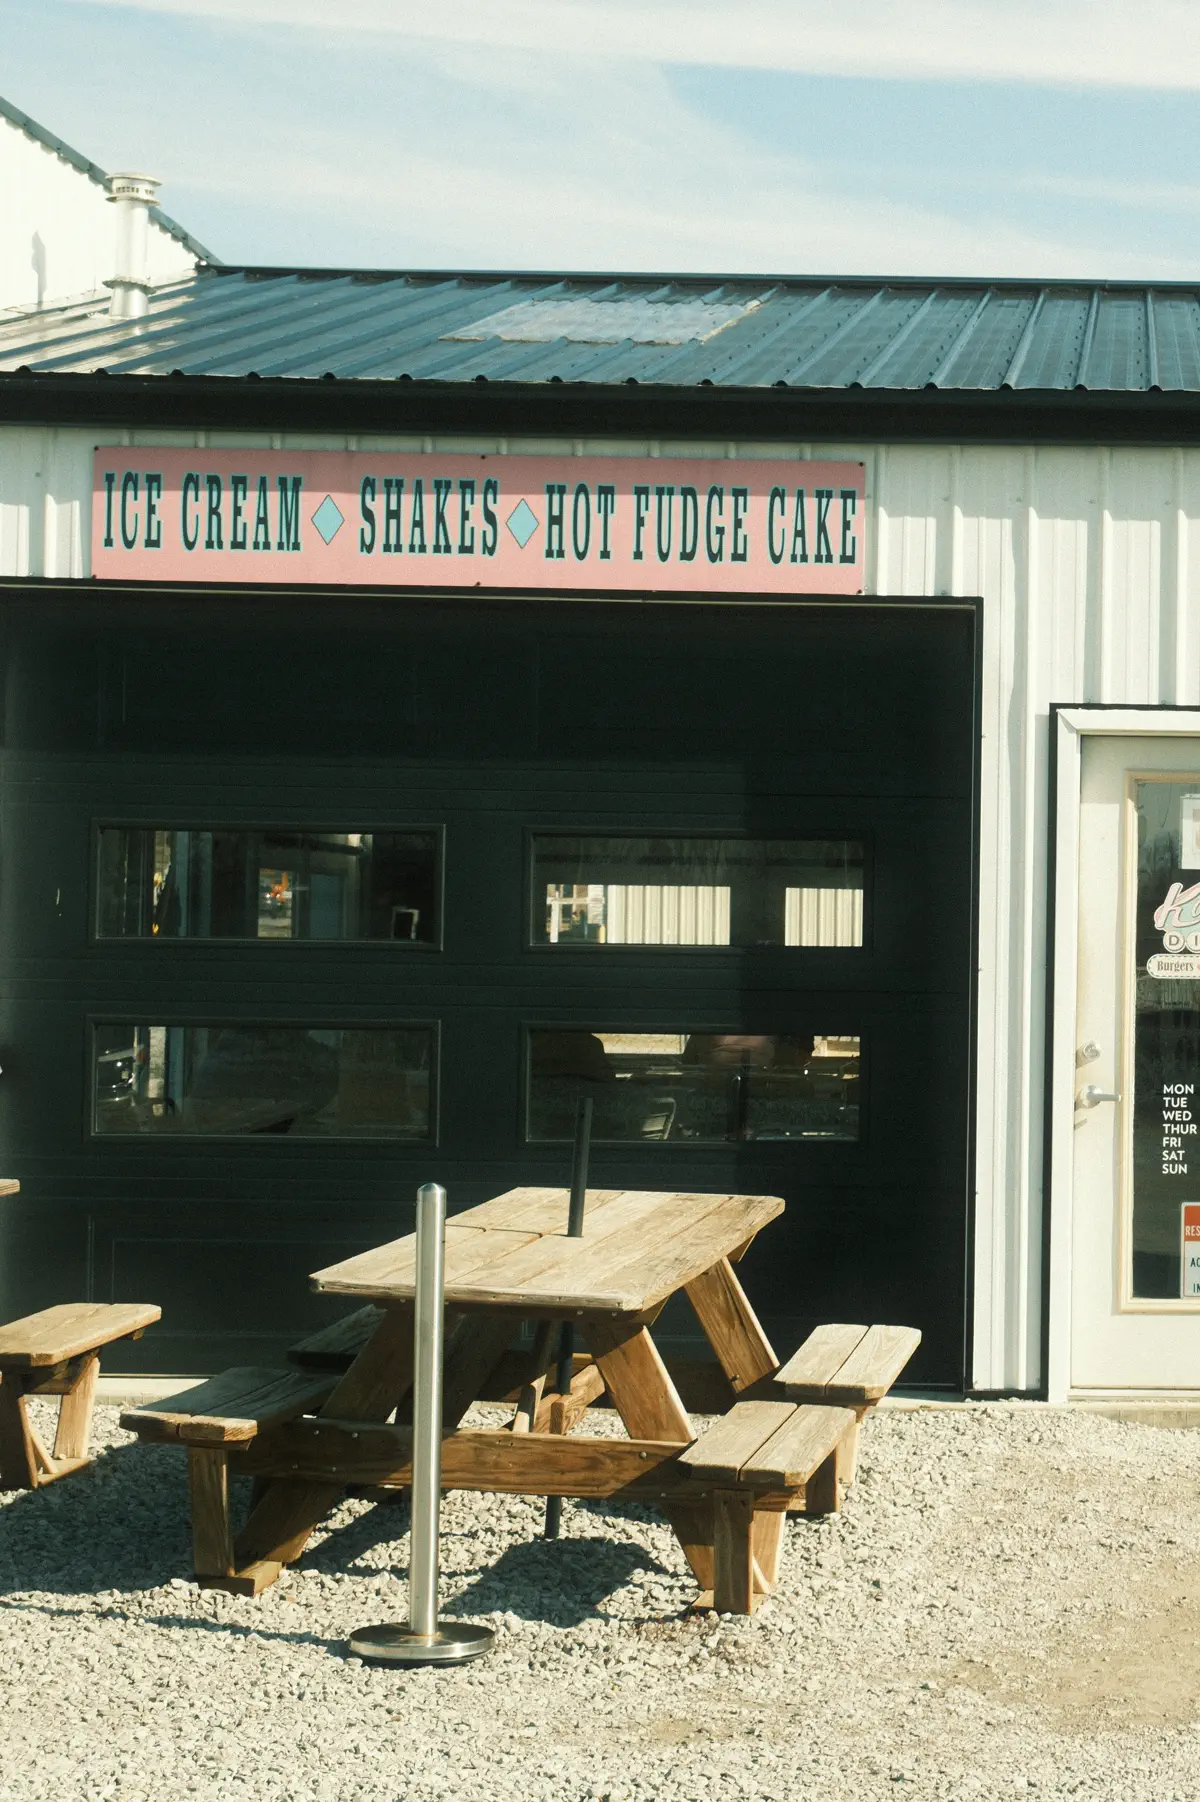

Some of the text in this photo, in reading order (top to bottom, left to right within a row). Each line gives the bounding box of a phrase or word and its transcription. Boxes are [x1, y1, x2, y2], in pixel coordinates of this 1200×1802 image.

[103, 471, 857, 565] ICE CREAM SHAKES HOT FUDGE CAKE
[1156, 960, 1194, 973] Burgers
[1163, 1084, 1194, 1094] MON
[1163, 1097, 1187, 1108] TUE
[1162, 1110, 1192, 1121] WED
[1162, 1124, 1197, 1135] THUR
[1162, 1137, 1182, 1148] FRI
[1162, 1150, 1185, 1161] SAT
[1162, 1163, 1188, 1174] SUN
